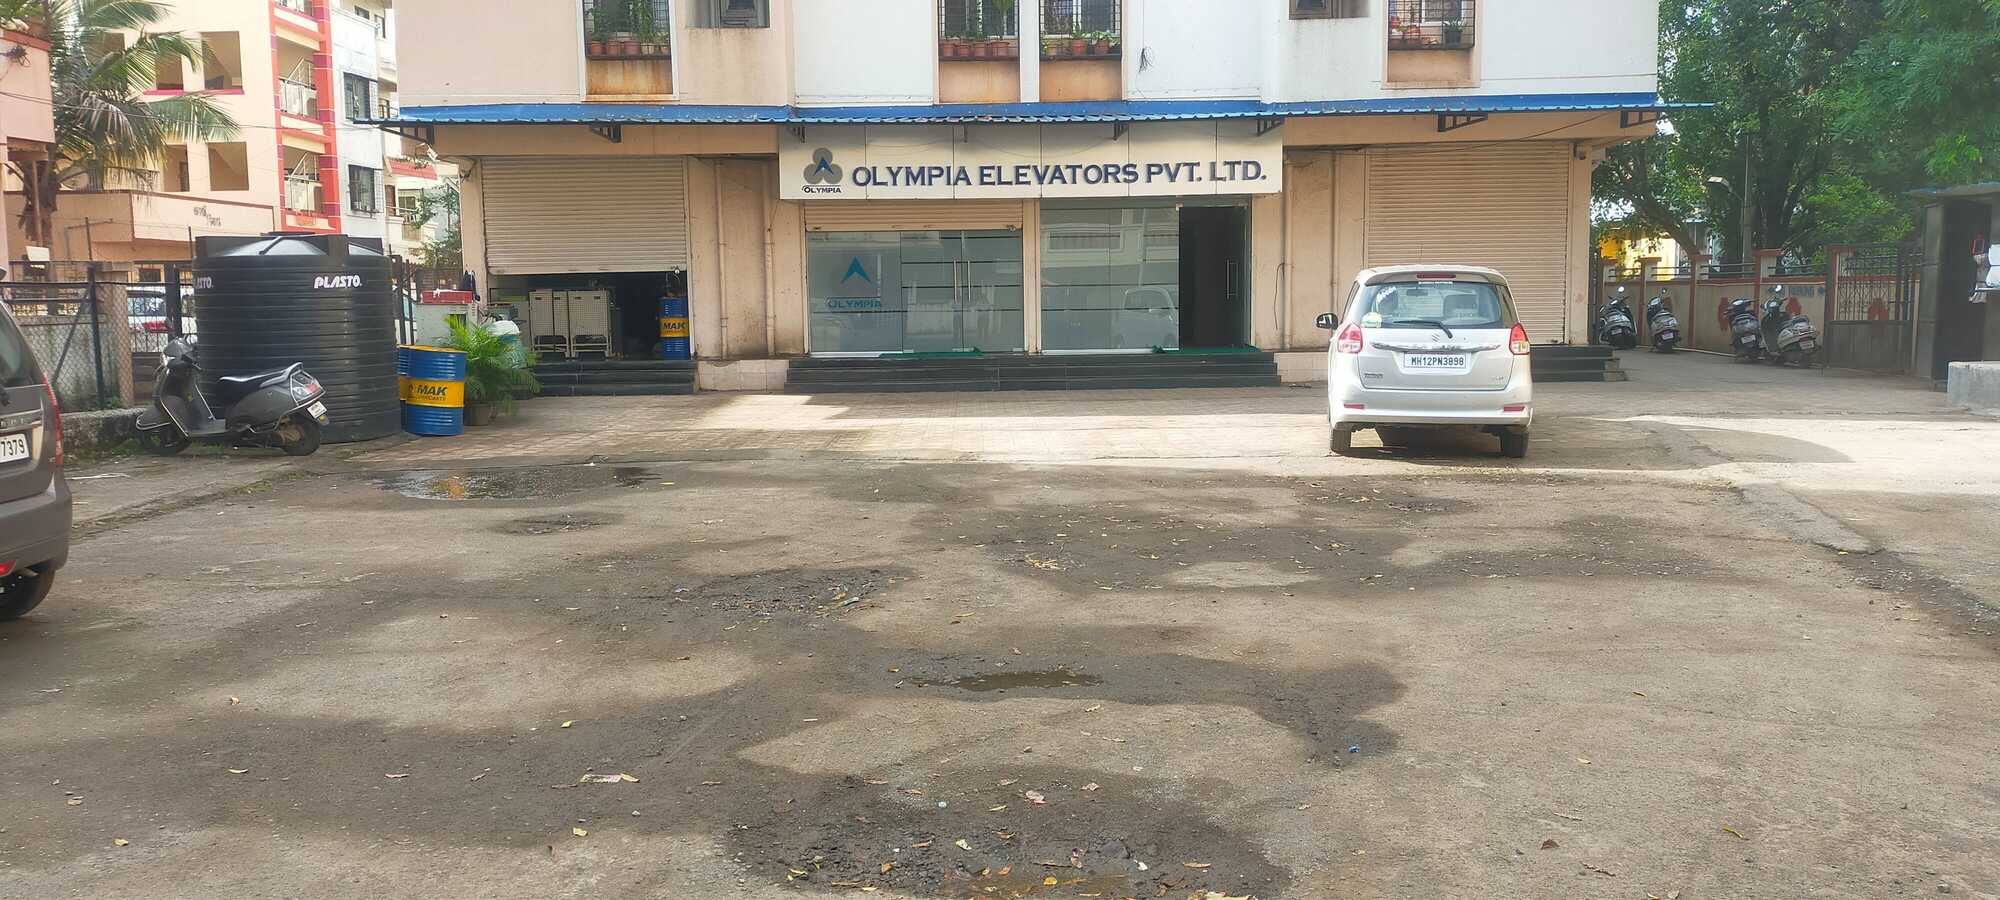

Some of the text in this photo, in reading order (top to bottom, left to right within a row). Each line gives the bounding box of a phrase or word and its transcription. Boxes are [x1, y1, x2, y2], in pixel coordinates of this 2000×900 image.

[852, 160, 1267, 187] OLYMPIA ELEVATORS PVT. LTD.
[827, 299, 882, 308] OLYMPIA
[663, 322, 689, 330] MAK
[417, 384, 448, 396] MAK
